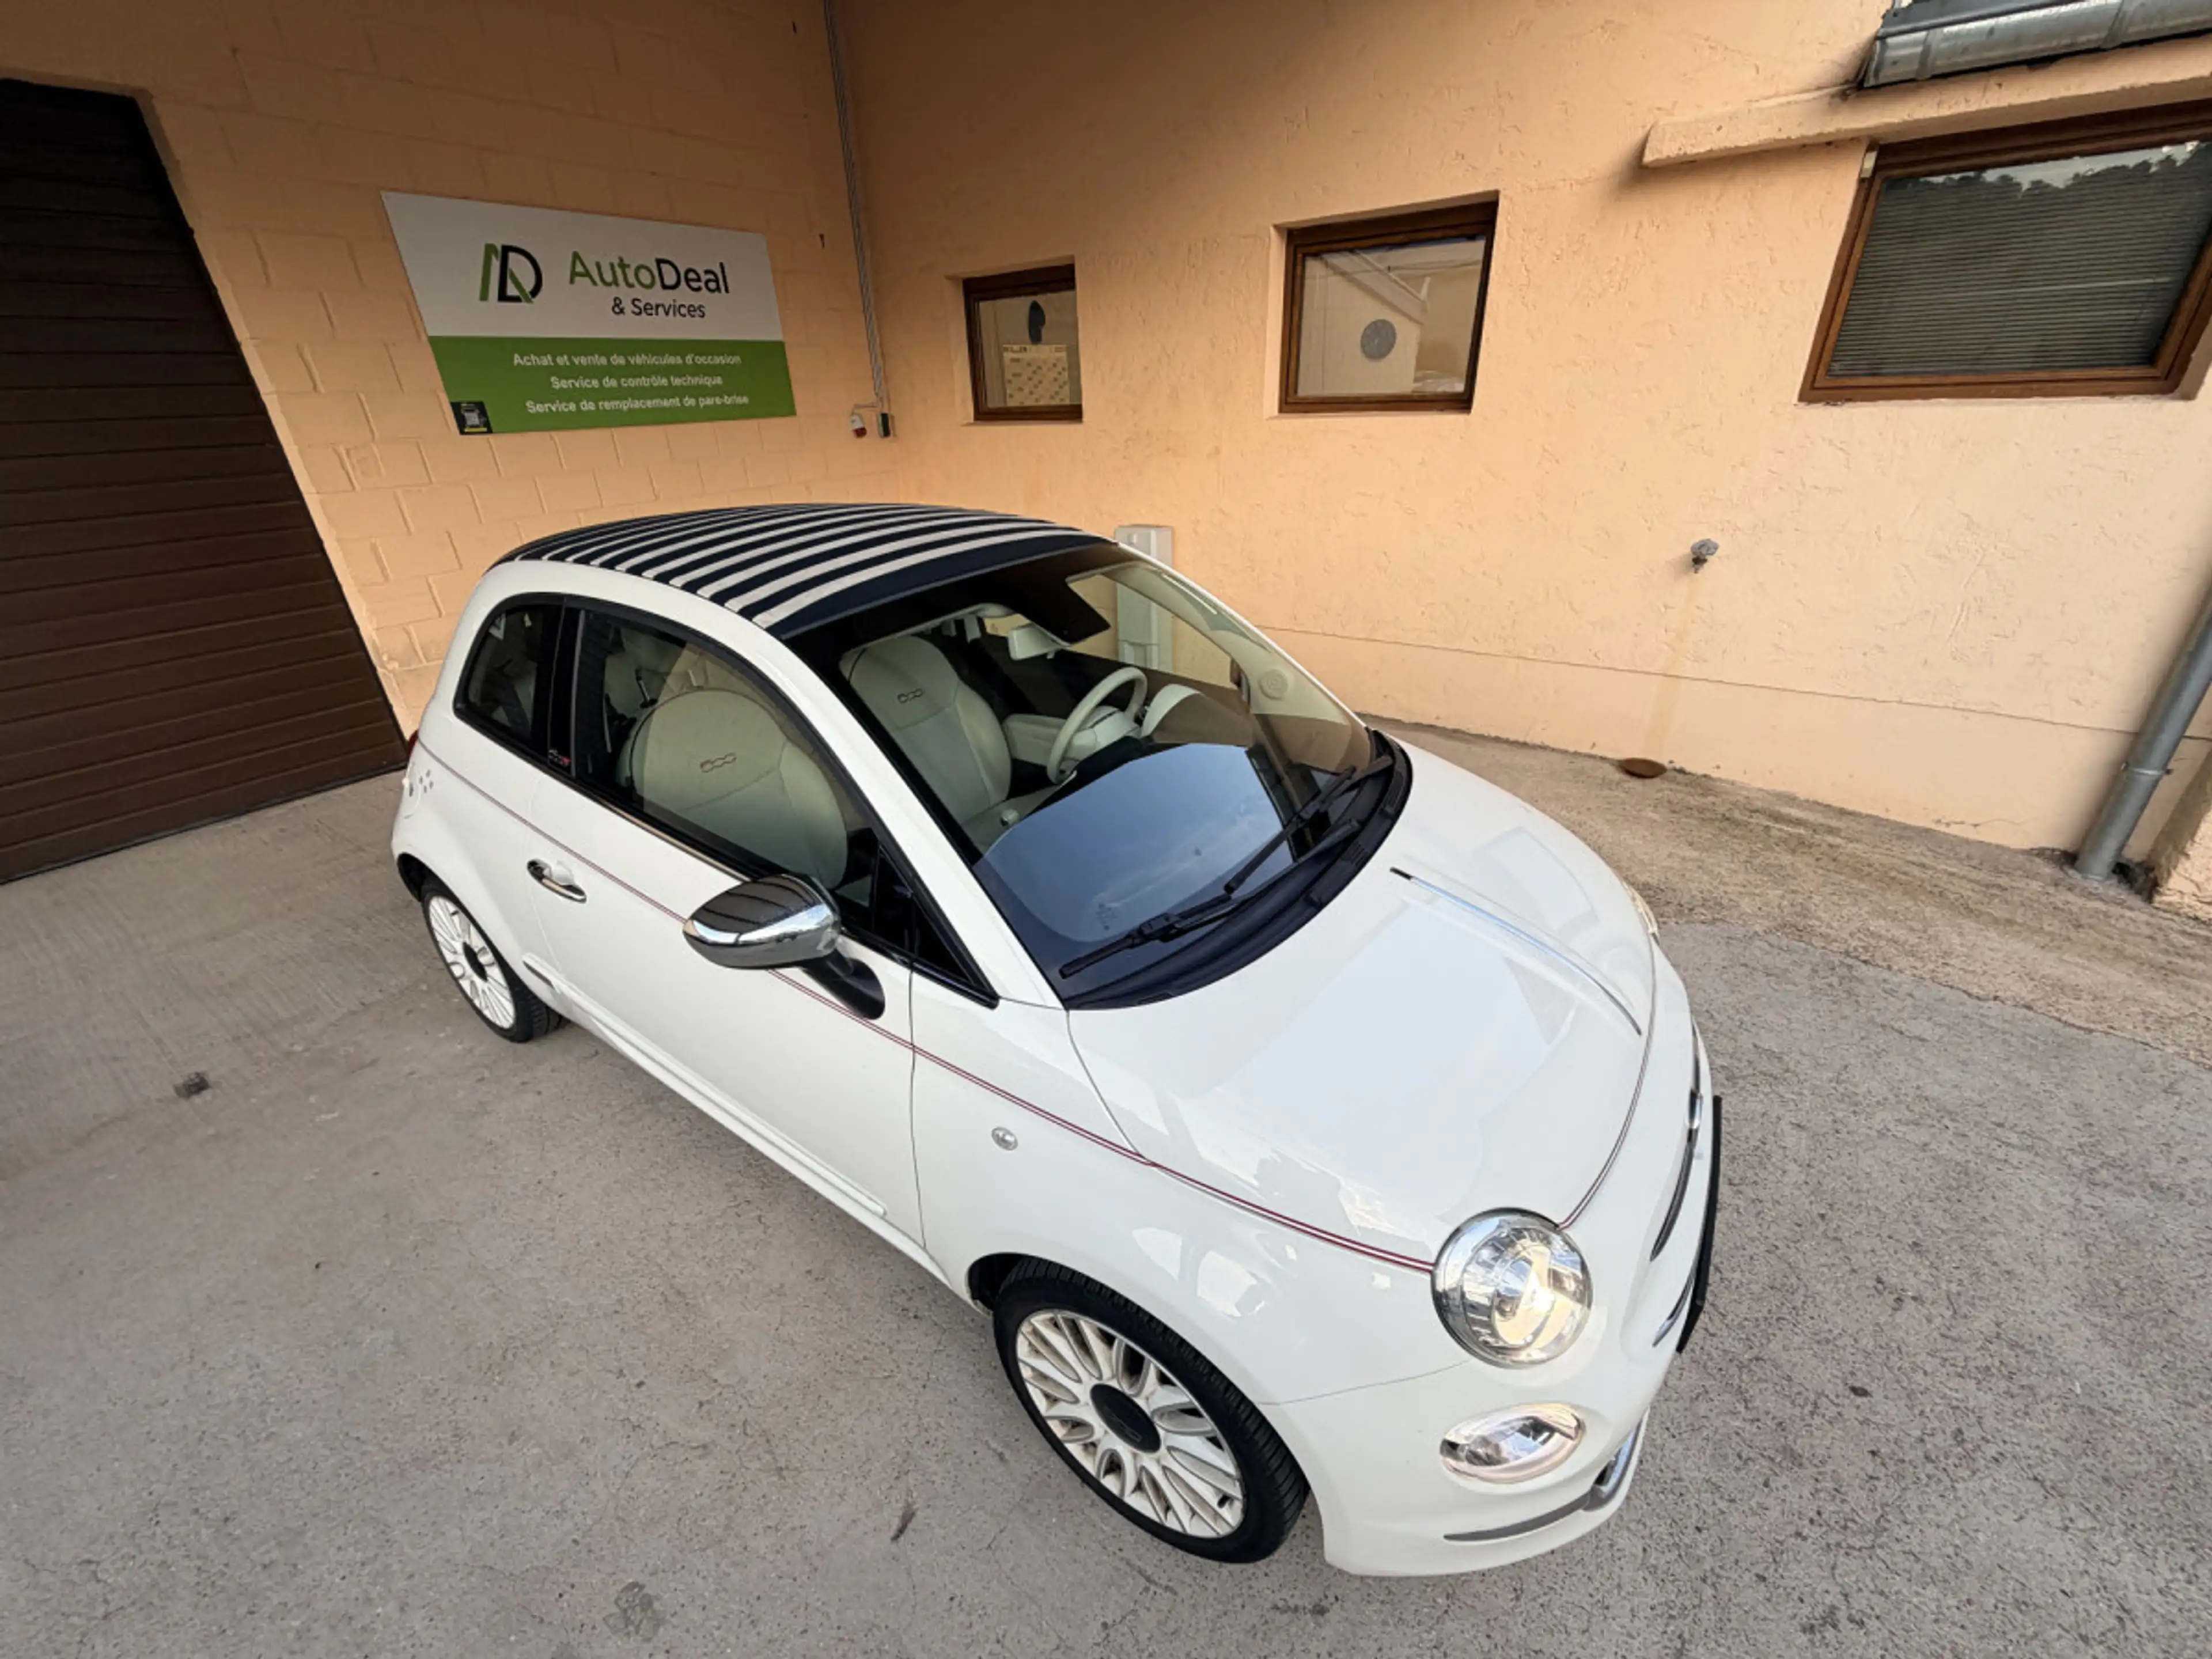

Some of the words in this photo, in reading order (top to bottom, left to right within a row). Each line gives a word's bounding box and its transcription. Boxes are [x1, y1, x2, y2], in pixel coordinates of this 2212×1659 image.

[569, 250, 730, 294] AutoDeal
[611, 297, 625, 315] &
[631, 297, 706, 318] Services
[514, 354, 554, 366] Achat
[556, 354, 570, 366] et
[571, 354, 607, 366] vente
[609, 354, 626, 365] de
[628, 354, 683, 366] véhicules
[685, 354, 742, 365] d'occasion
[551, 376, 600, 389] Service
[603, 376, 618, 388] de
[620, 375, 669, 387] contrôle
[671, 374, 724, 387] technique
[525, 400, 576, 414] Service
[579, 399, 596, 411] de
[599, 397, 681, 411] remplacement
[683, 395, 696, 407] de
[699, 393, 749, 408] pare-brise
